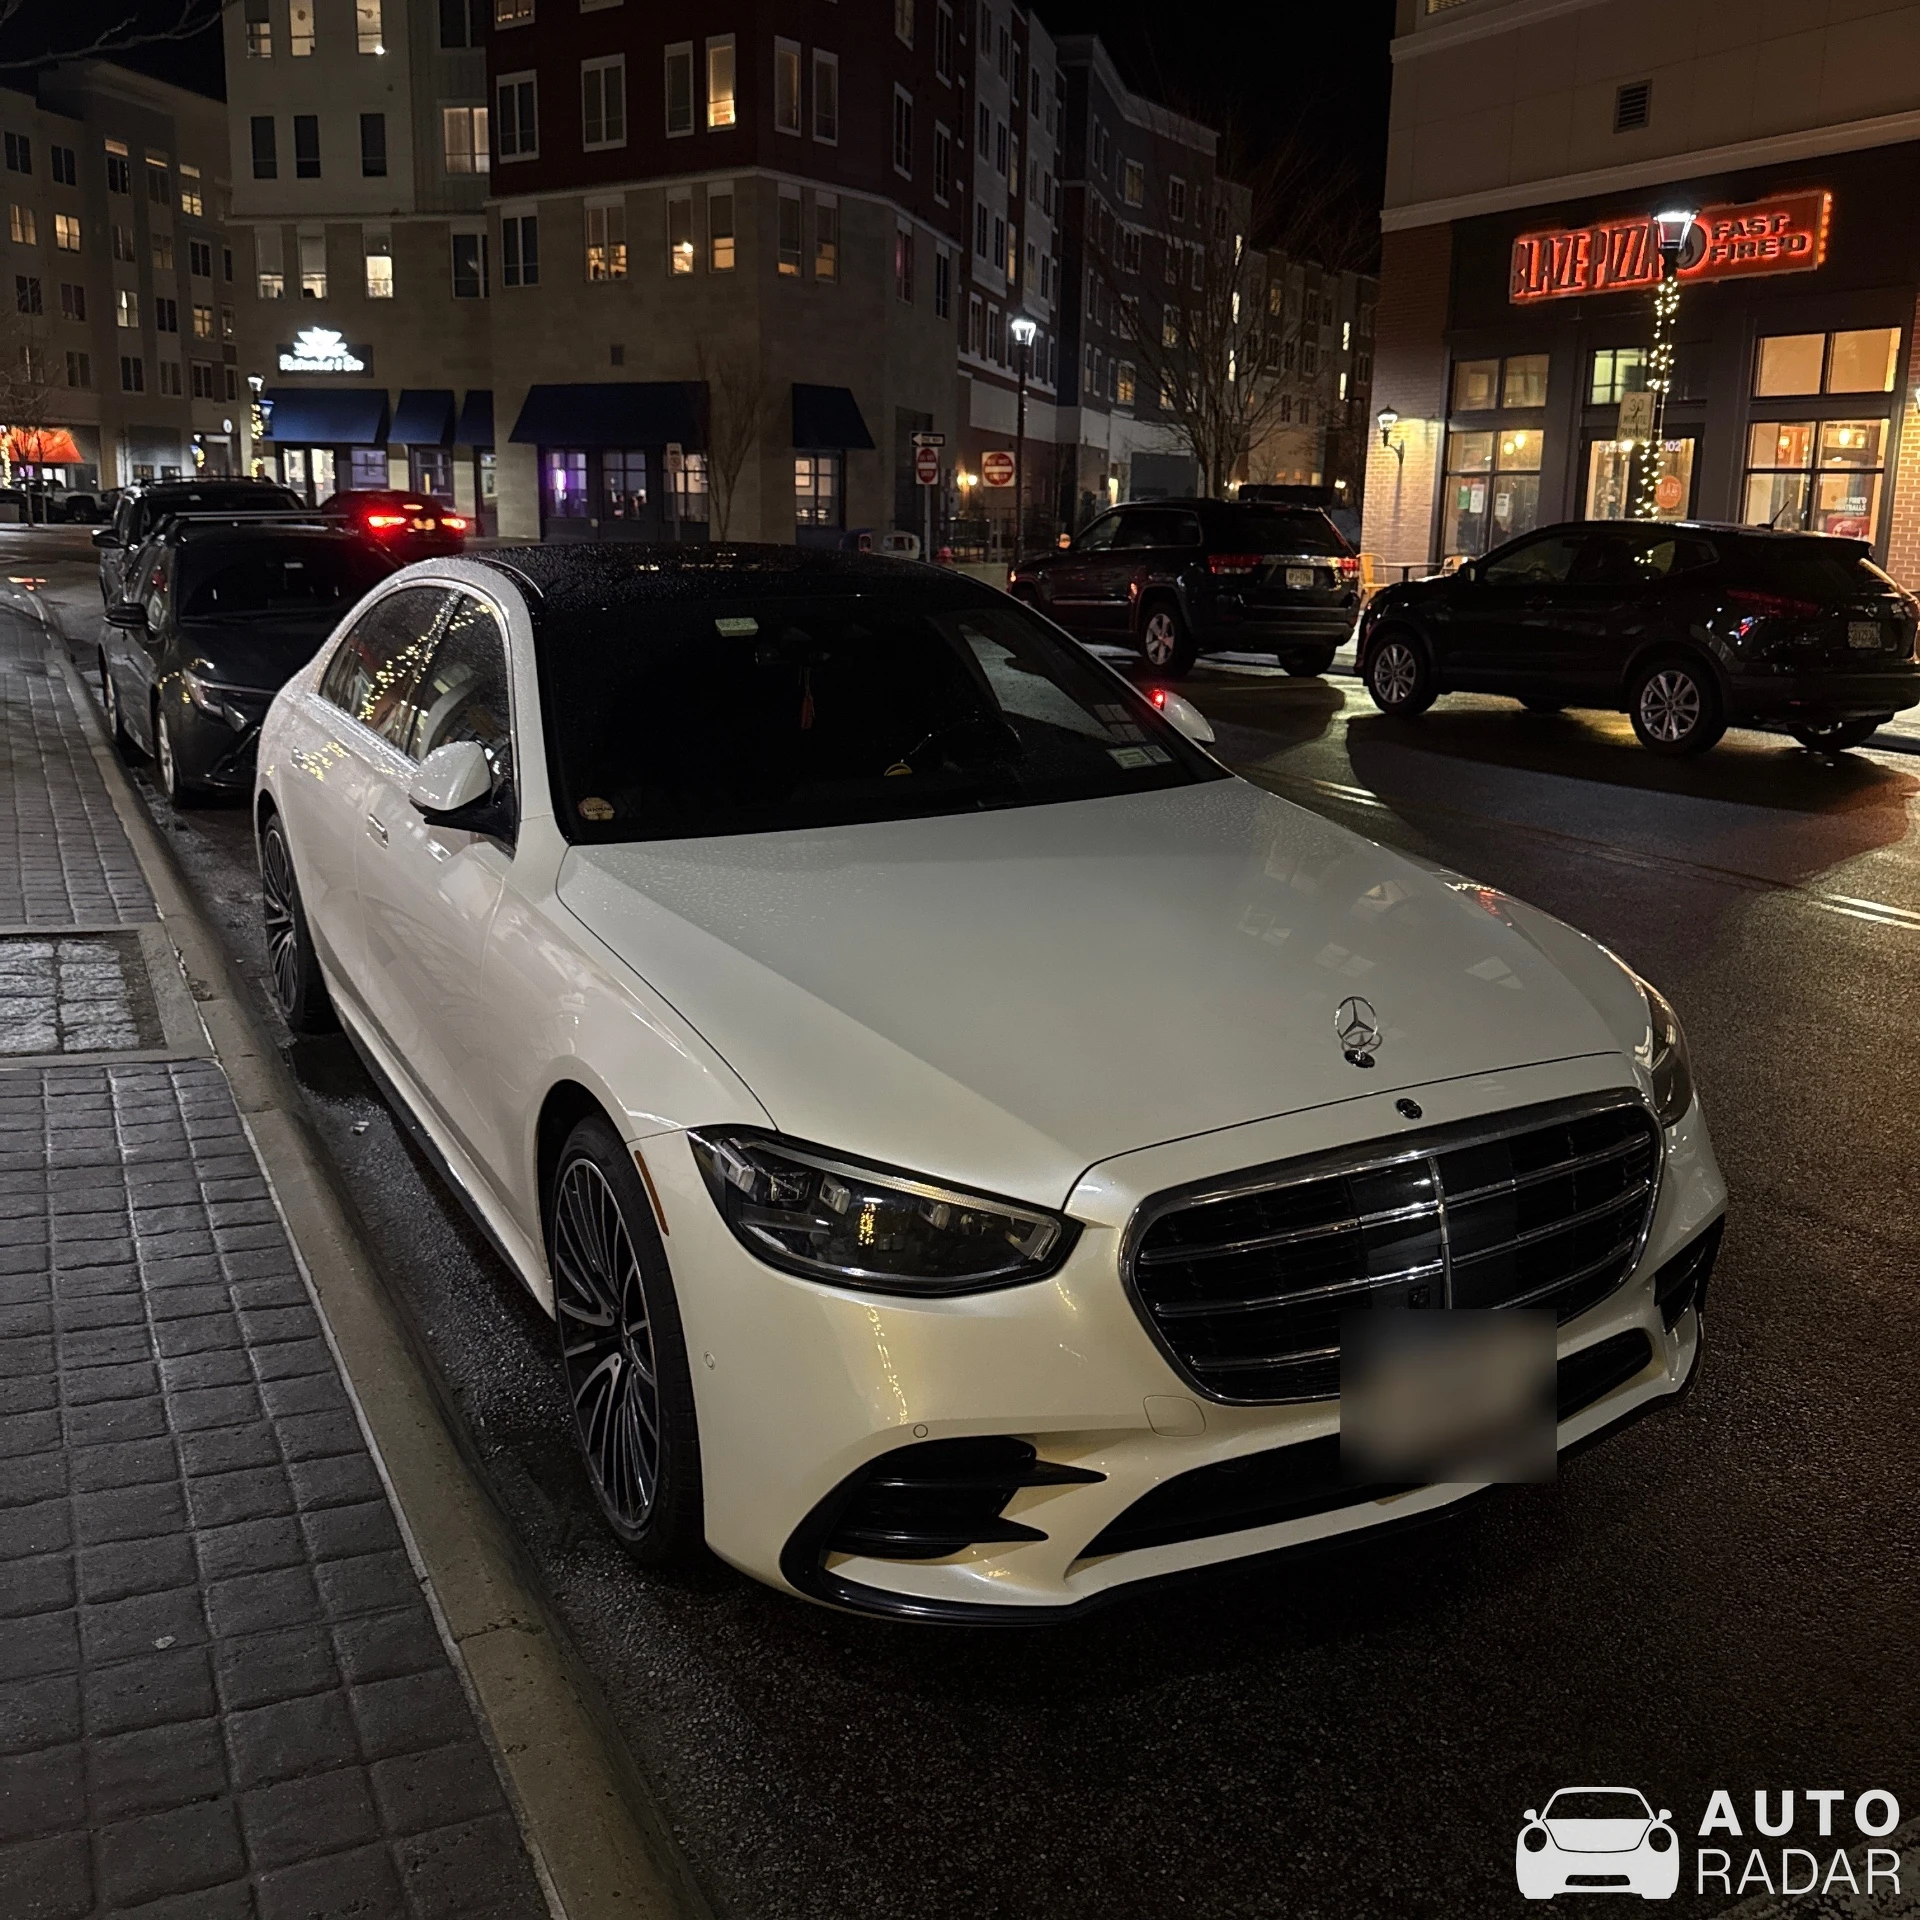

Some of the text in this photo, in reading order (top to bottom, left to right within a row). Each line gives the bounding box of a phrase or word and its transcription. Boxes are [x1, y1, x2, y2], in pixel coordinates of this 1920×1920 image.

[1711, 213, 1786, 240] FAST
[1510, 222, 1664, 295] BLAZE PIZZA
[1708, 233, 1808, 262] FIRE'D
[1664, 441, 1681, 452] 102
